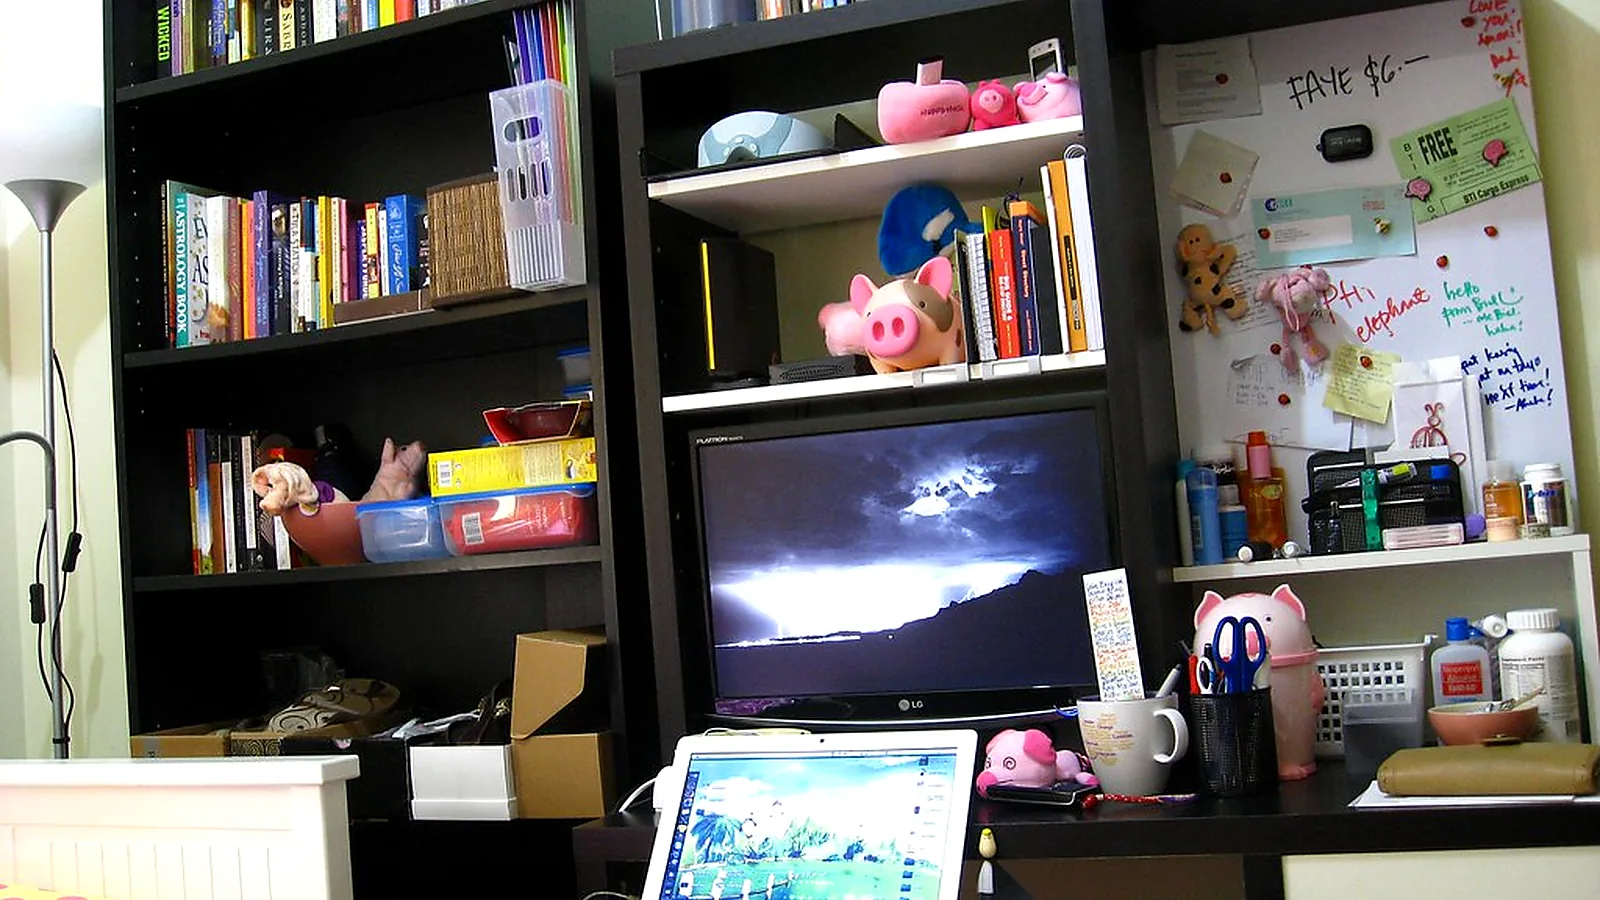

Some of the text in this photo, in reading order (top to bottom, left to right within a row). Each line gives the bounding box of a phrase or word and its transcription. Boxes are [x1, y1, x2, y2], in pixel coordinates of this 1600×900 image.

[157, 6, 171, 61] WICKED
[1286, 66, 1353, 110] FAYE
[1417, 127, 1458, 165] FREE
[1463, 174, 1530, 204] BTI Cargo Express
[176, 211, 188, 333] ASTROLOGY BOOK
[1443, 281, 1480, 300] hello
[911, 700, 924, 709] LG
